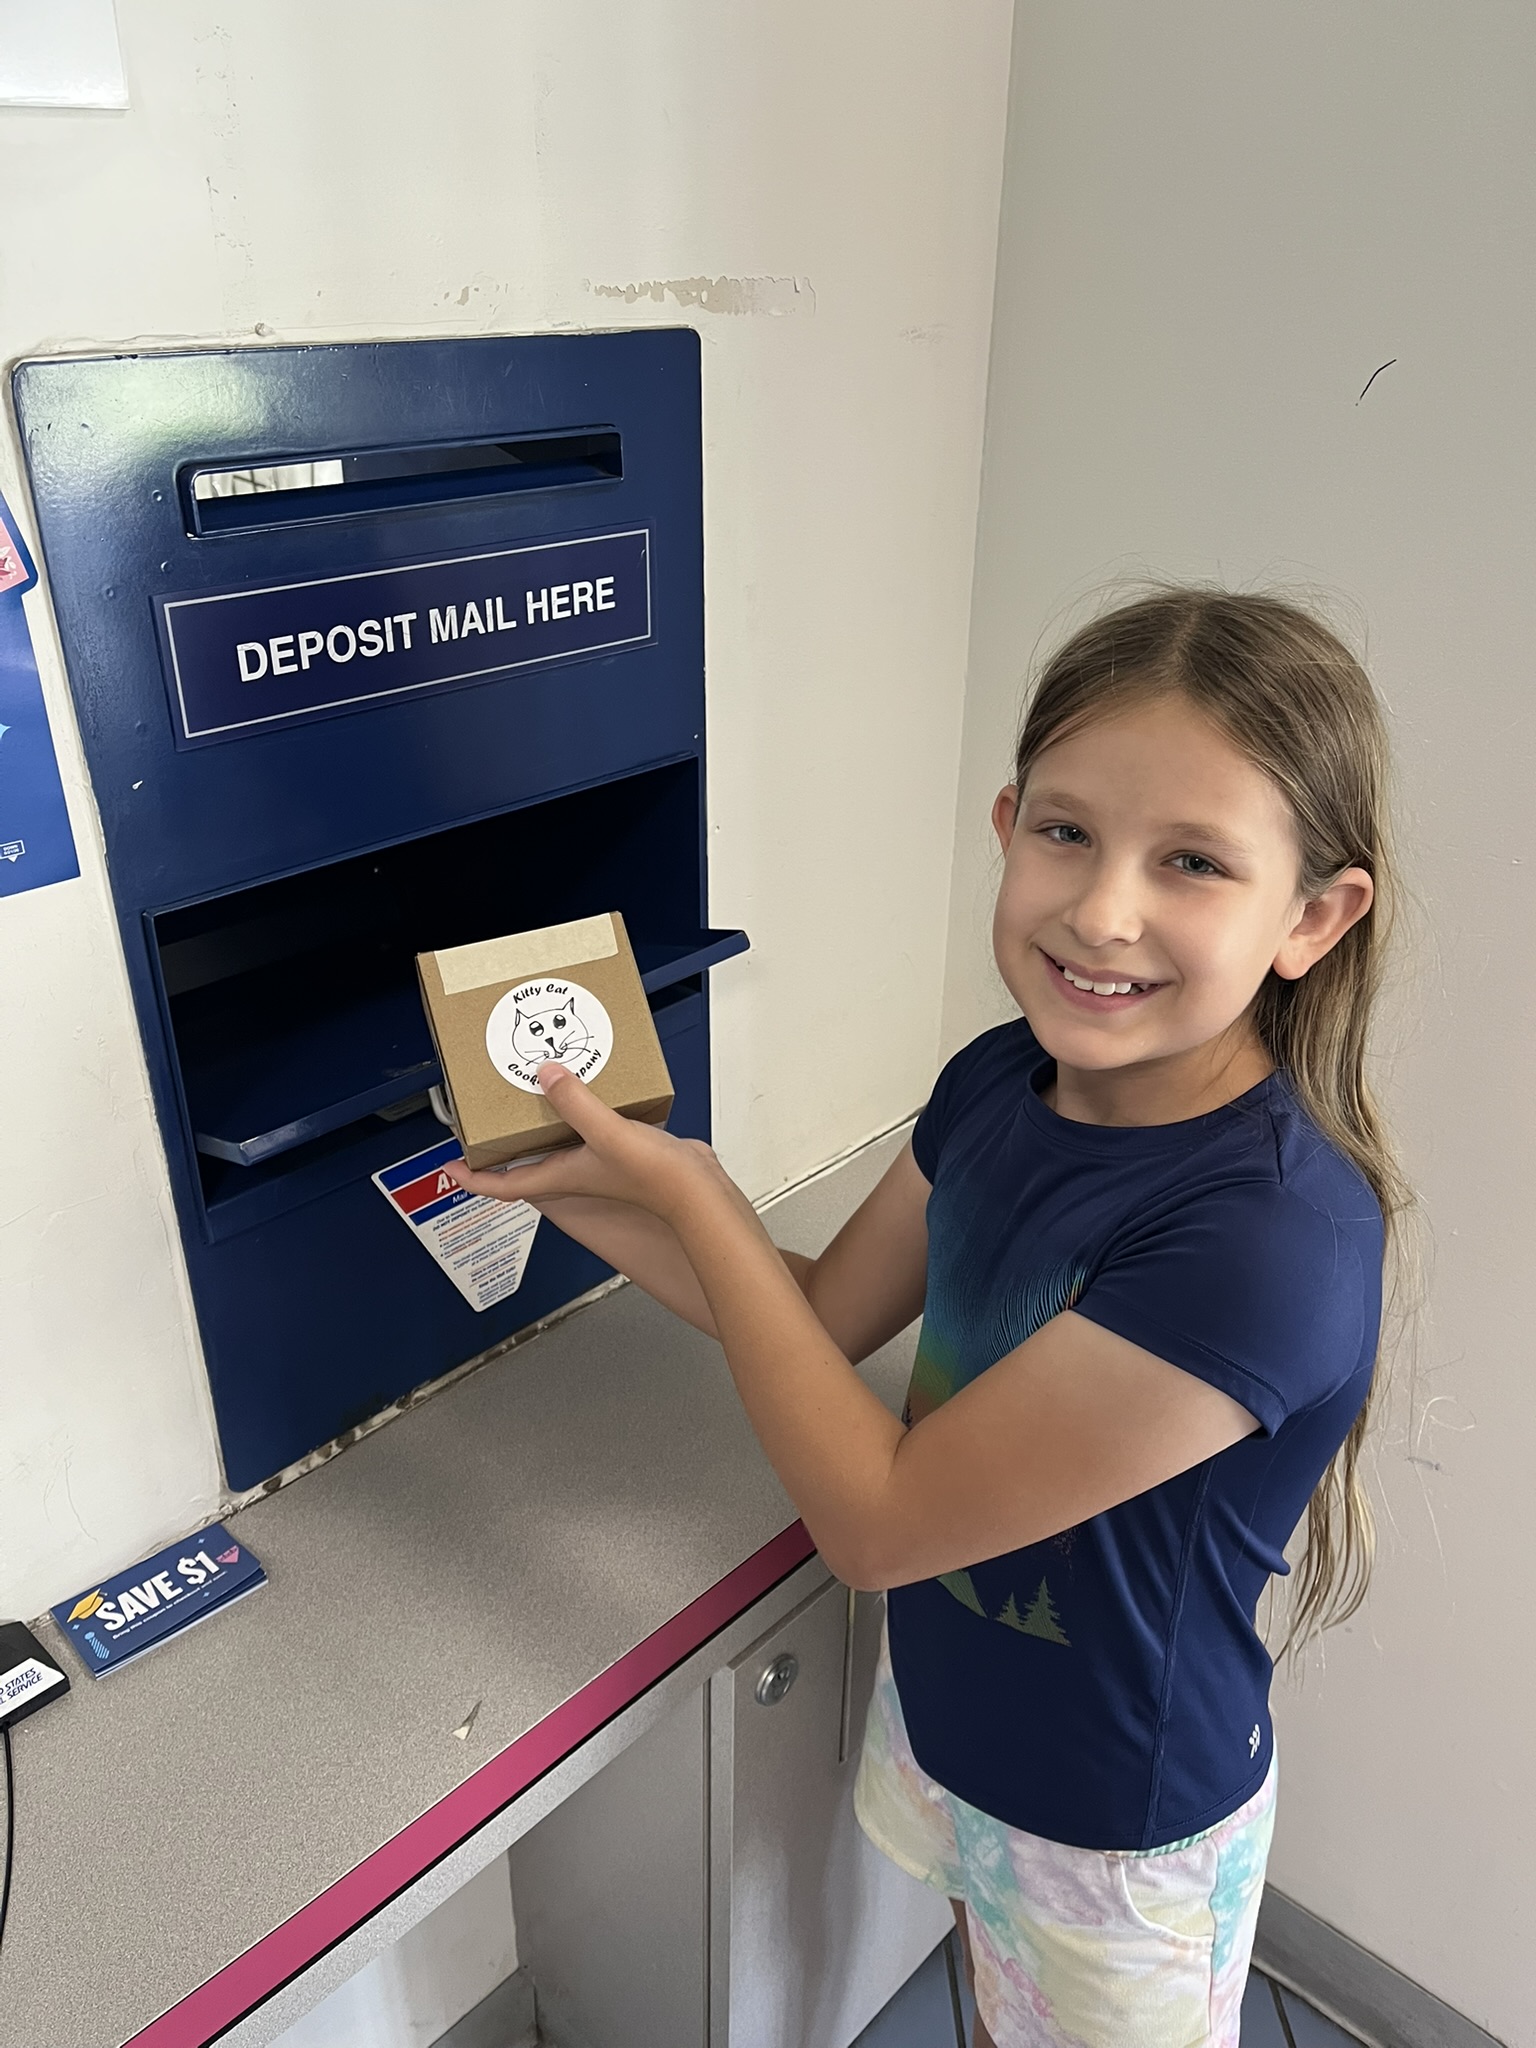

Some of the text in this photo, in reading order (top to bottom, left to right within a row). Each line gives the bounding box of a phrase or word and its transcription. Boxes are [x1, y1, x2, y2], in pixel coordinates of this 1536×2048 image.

[236, 576, 616, 683] DEPOSIT MAIL HERE
[513, 983, 569, 1004] Kitty Cat
[507, 1048, 602, 1086] Cook pany
[94, 1570, 184, 1632] SAVE
[176, 1550, 220, 1586] $1
[4, 1667, 36, 1692] STATES
[7, 1672, 44, 1700] SERVICE
